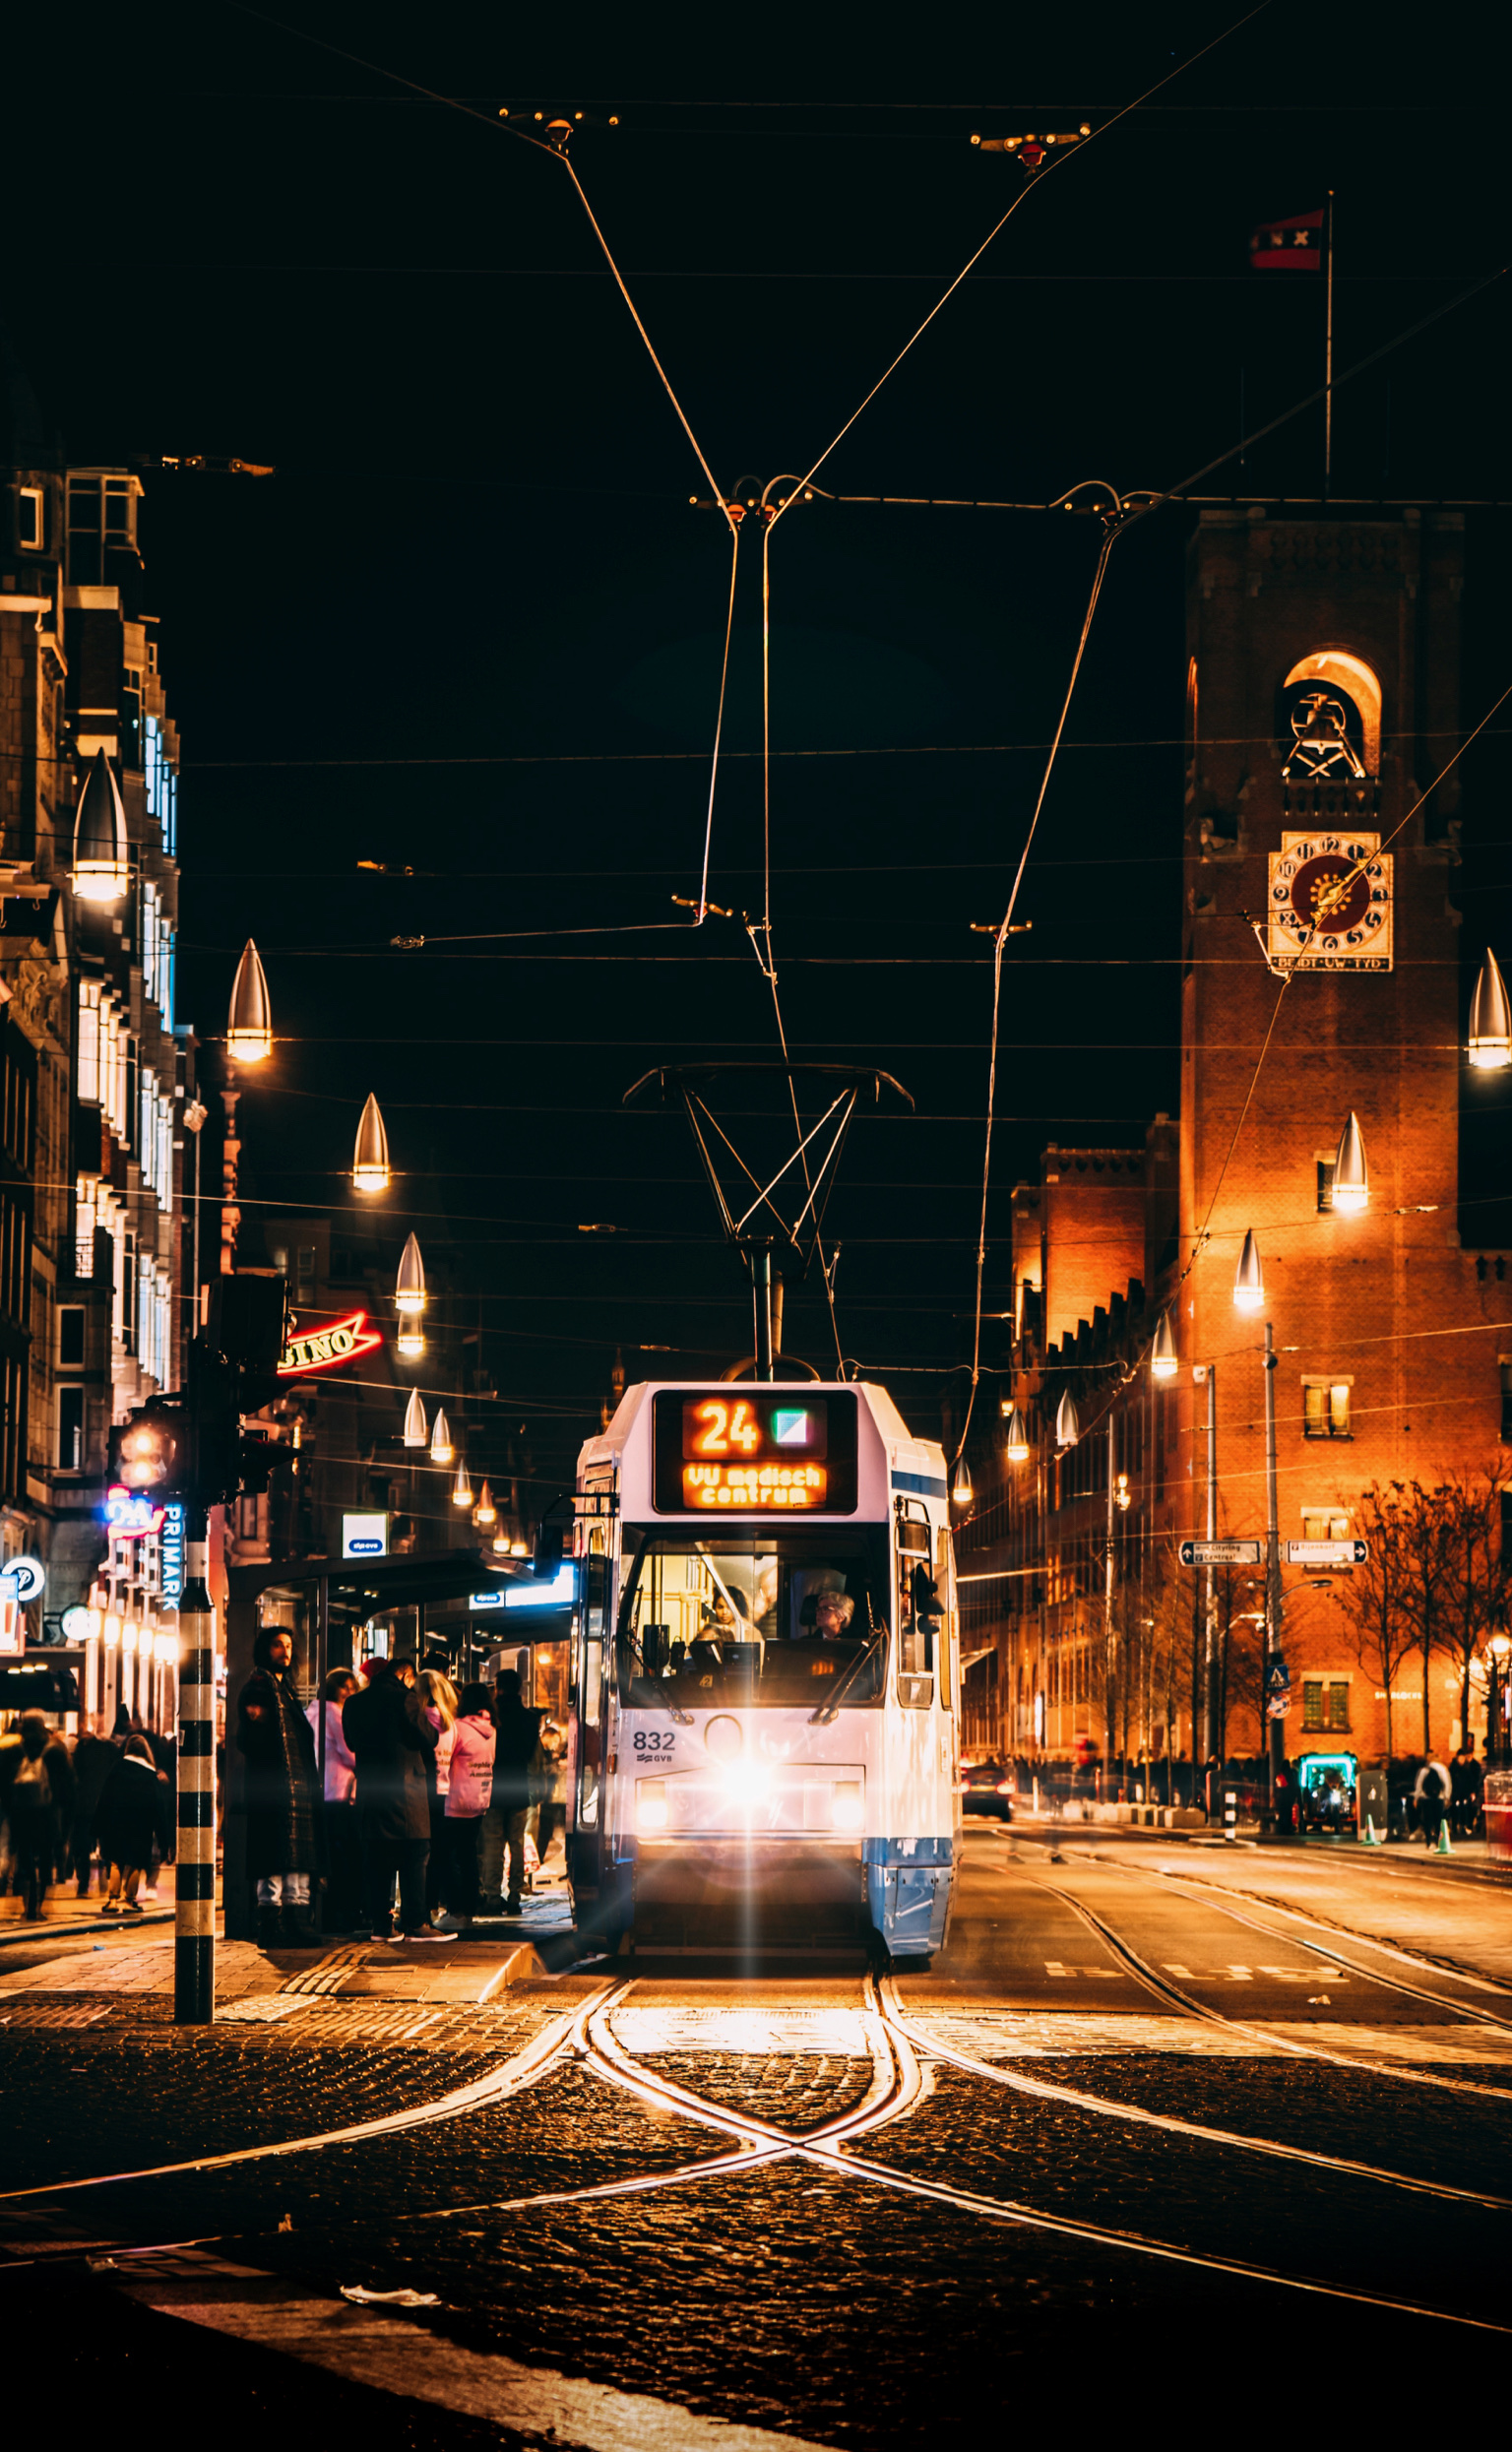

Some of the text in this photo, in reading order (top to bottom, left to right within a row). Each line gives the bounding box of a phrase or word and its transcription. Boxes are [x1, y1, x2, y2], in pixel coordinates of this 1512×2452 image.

[1299, 845, 1312, 859] 11
[1323, 838, 1338, 852] 12
[1281, 862, 1295, 877] 10
[1369, 864, 1379, 878] 2
[1276, 888, 1287, 901] 9
[1282, 912, 1292, 925] 8
[1368, 912, 1378, 927] 4
[1300, 929, 1313, 944] 7
[1325, 936, 1336, 951] 6
[1351, 930, 1360, 945] 5
[1324, 958, 1346, 968] UW
[700, 1404, 758, 1451] 24
[688, 1466, 820, 1487] VU medisch
[702, 1486, 807, 1504] centrum
[1211, 1543, 1240, 1552] Cityring
[162, 1503, 181, 1611] PRIMARK
[633, 1731, 675, 1750] 832
